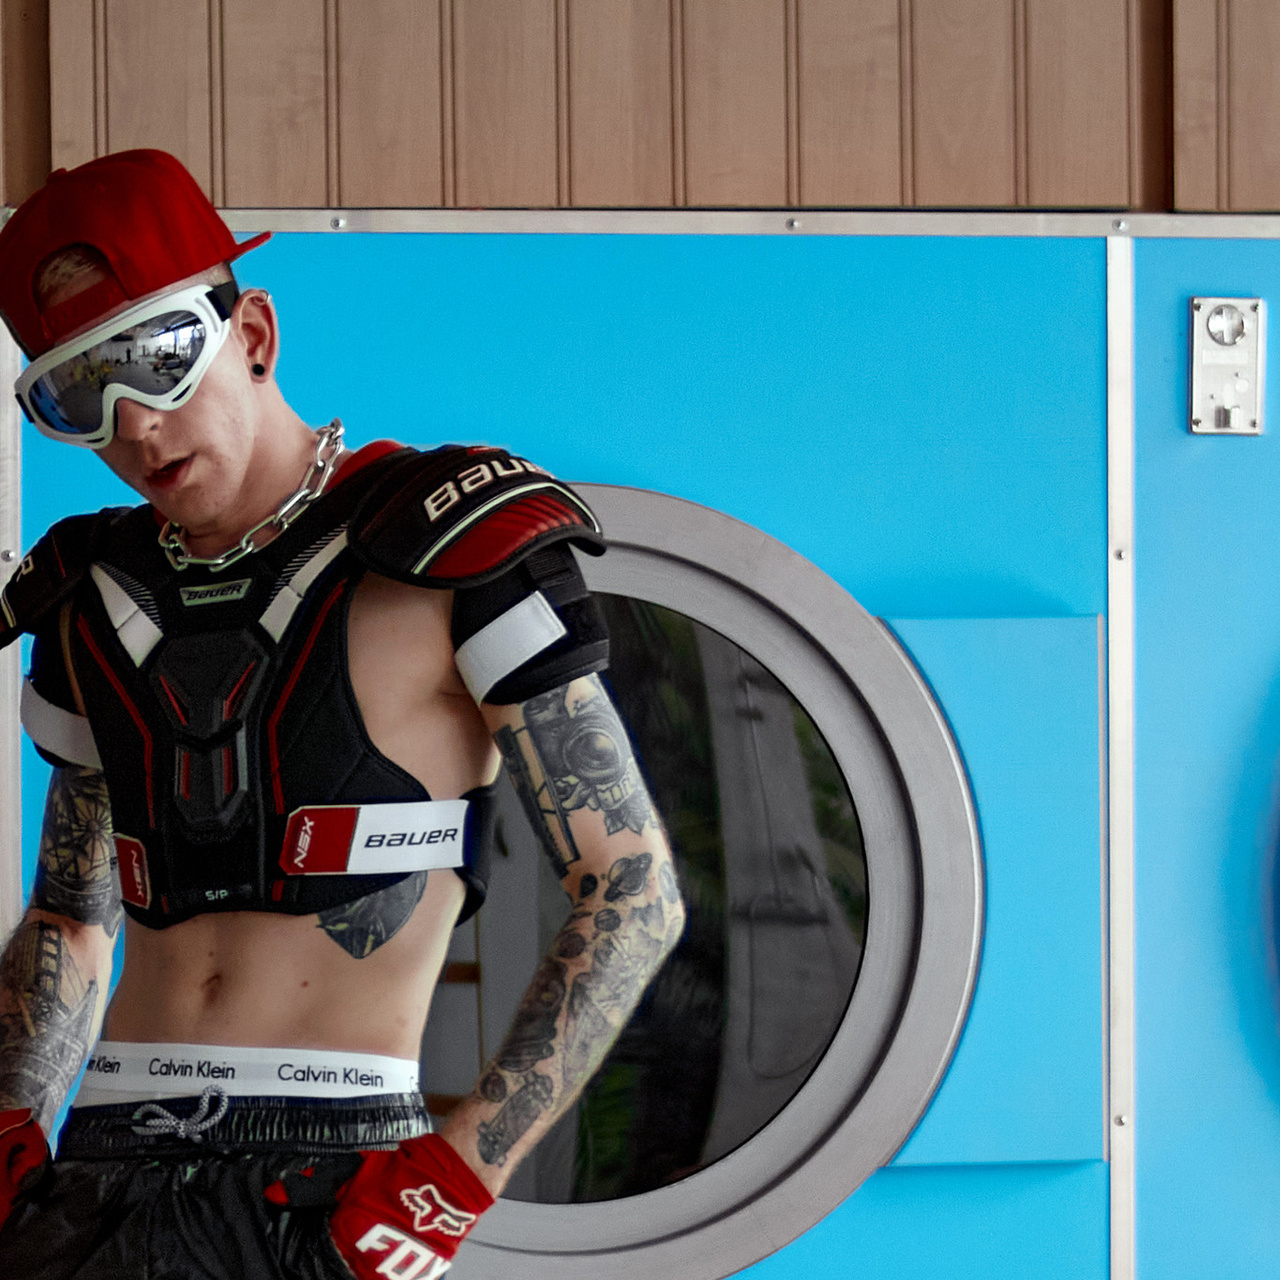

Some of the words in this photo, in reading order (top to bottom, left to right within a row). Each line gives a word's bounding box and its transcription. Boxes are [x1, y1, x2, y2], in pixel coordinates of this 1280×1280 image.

[363, 828, 459, 849] BAUER
[148, 1058, 193, 1077] Calvin
[196, 1060, 236, 1080] Klein
[277, 1063, 338, 1084] Calvin
[342, 1067, 384, 1088] Klein
